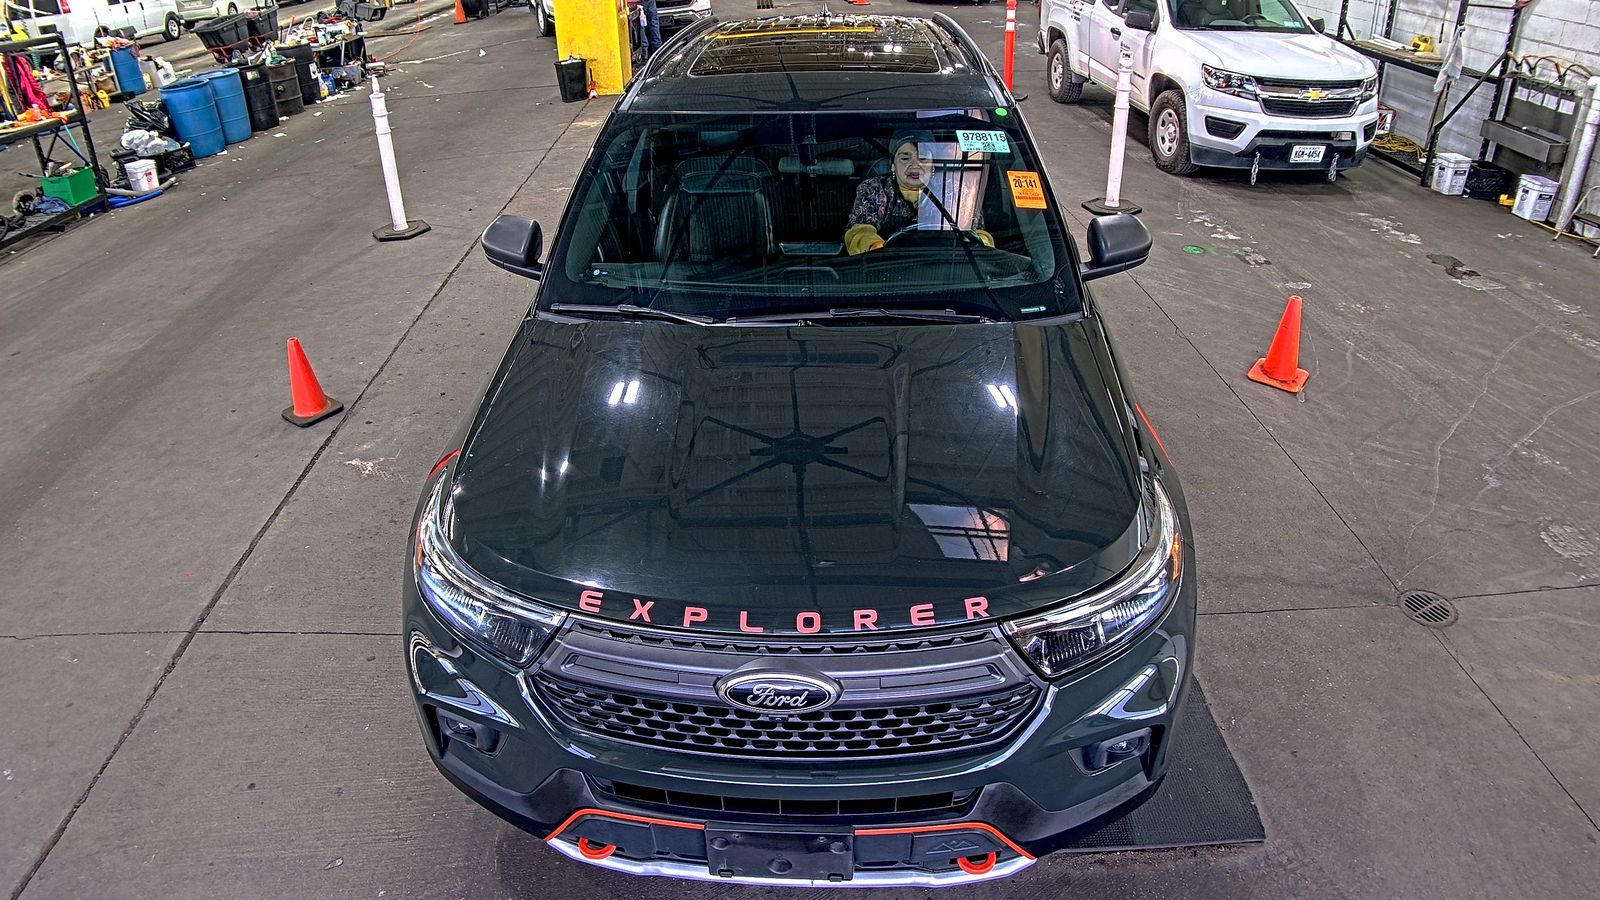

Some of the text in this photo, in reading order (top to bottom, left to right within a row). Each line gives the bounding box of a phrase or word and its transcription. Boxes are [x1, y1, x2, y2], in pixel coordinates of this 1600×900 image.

[962, 132, 1006, 142] 9788115
[579, 591, 990, 633] EXPLORER
[747, 683, 808, 707] Ford
